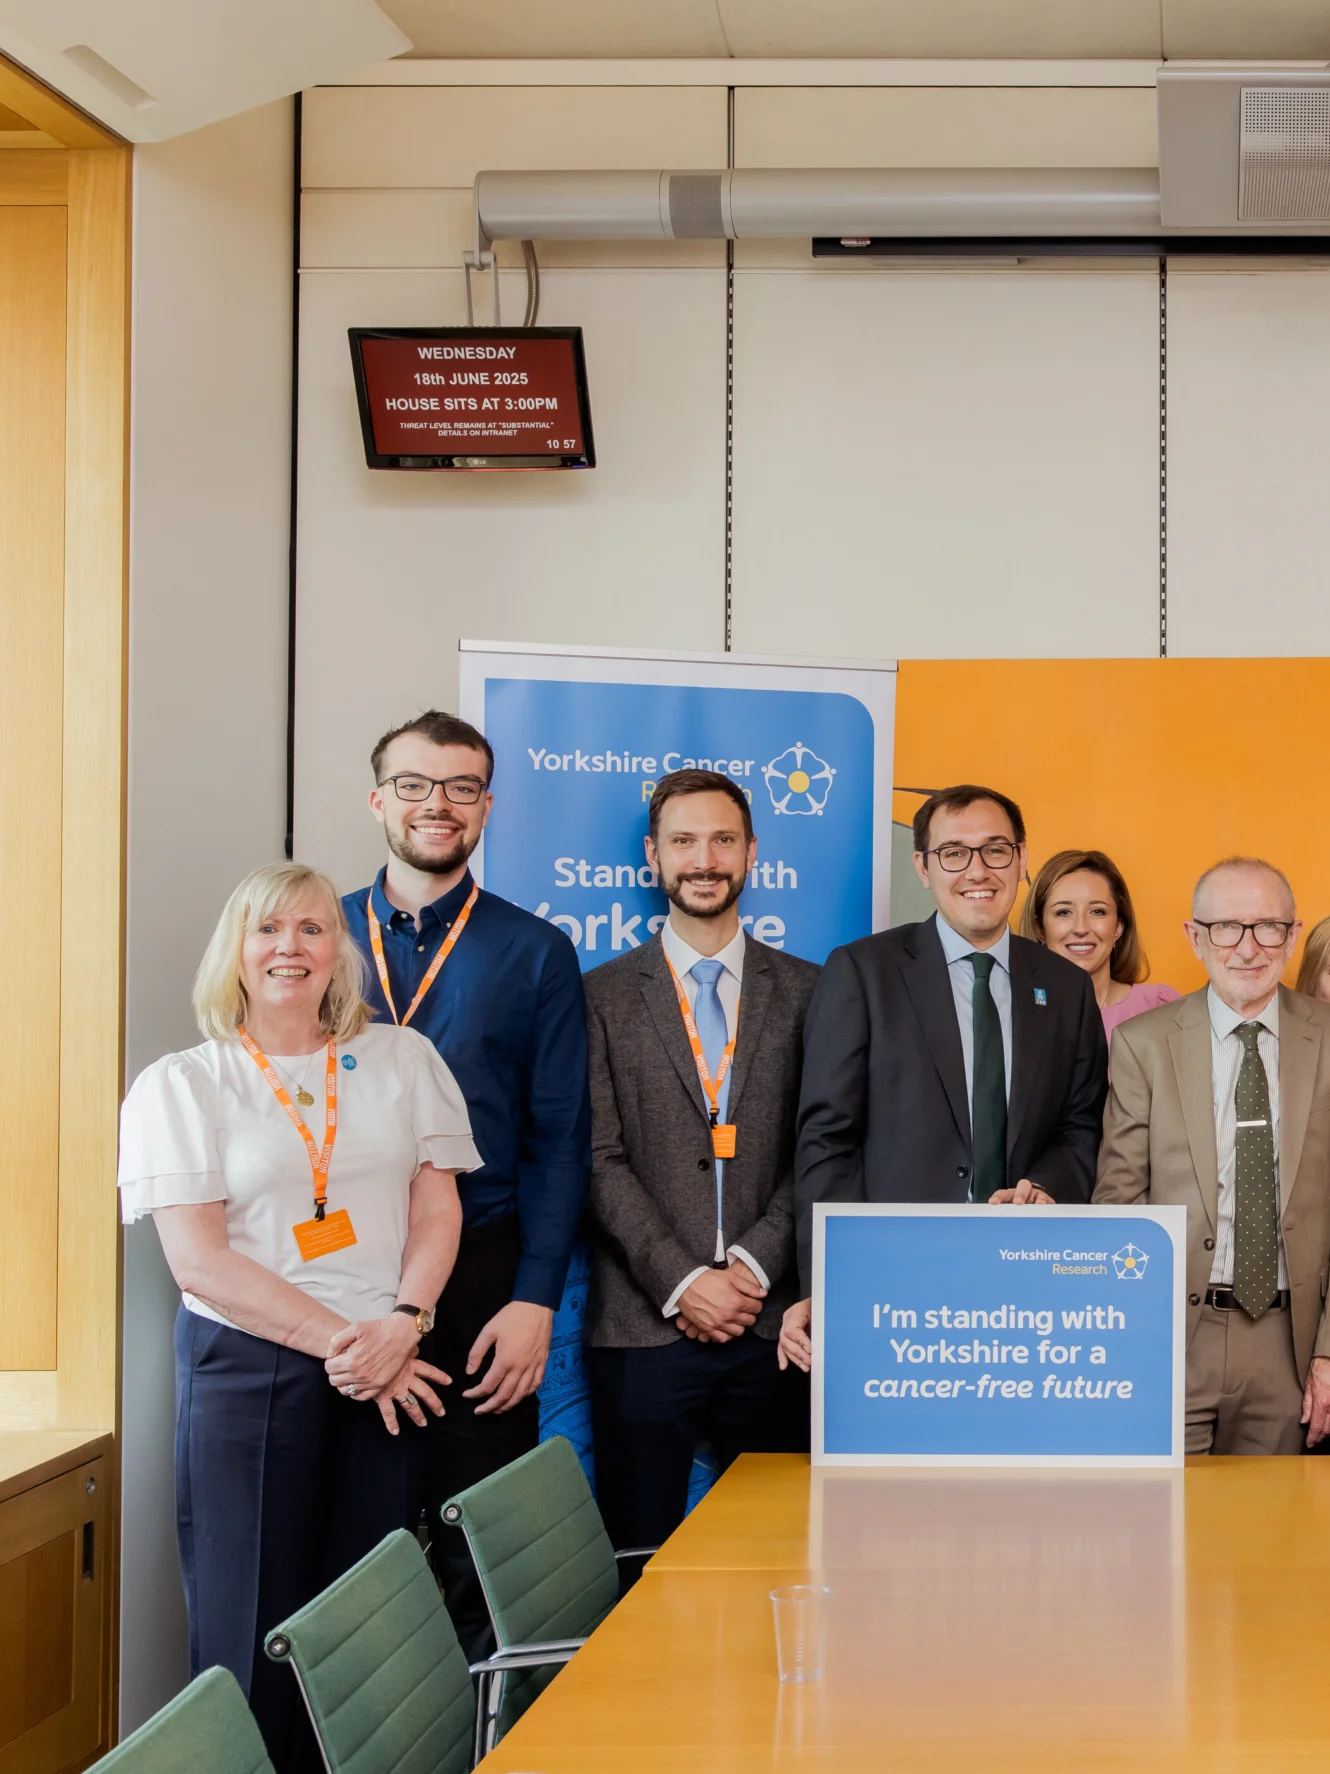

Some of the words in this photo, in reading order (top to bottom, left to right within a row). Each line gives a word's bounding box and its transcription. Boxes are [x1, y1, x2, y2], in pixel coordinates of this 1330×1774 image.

[418, 347, 516, 360] WEDNESDAY
[414, 373, 445, 385] 18th
[450, 373, 490, 385] JUNE
[494, 373, 528, 385] 2025
[386, 398, 440, 411] HOUSE
[444, 398, 477, 411] SITS
[482, 398, 500, 410] AT
[505, 398, 558, 410] 3:00PM
[546, 440, 559, 449] 10
[563, 440, 576, 449] 57
[528, 748, 656, 773] Yorkshire
[554, 857, 658, 888] Stand
[745, 860, 797, 889] ith
[448, 918, 464, 942] VISITOR
[427, 954, 446, 980] VISITOR
[684, 1012, 697, 1039] VISITOR
[696, 1054, 710, 1081] VISITOR
[717, 1054, 730, 1080] VISITOR
[327, 1074, 336, 1096] VISITOR
[285, 1103, 304, 1126] VISITOR
[307, 1140, 320, 1169] VISITOR
[319, 1144, 332, 1174] VISITOR
[999, 1249, 1060, 1262] Yorkshire
[1062, 1250, 1108, 1262] Cancer
[1052, 1264, 1107, 1275] Research
[873, 1304, 916, 1328] I'm
[925, 1304, 1053, 1336] standing
[1061, 1305, 1126, 1330] with
[890, 1339, 1029, 1364] Yorkshire
[1037, 1339, 1081, 1364] for
[1089, 1345, 1106, 1364] a
[864, 1374, 1034, 1399] cancer-free
[1042, 1374, 1133, 1399] future
